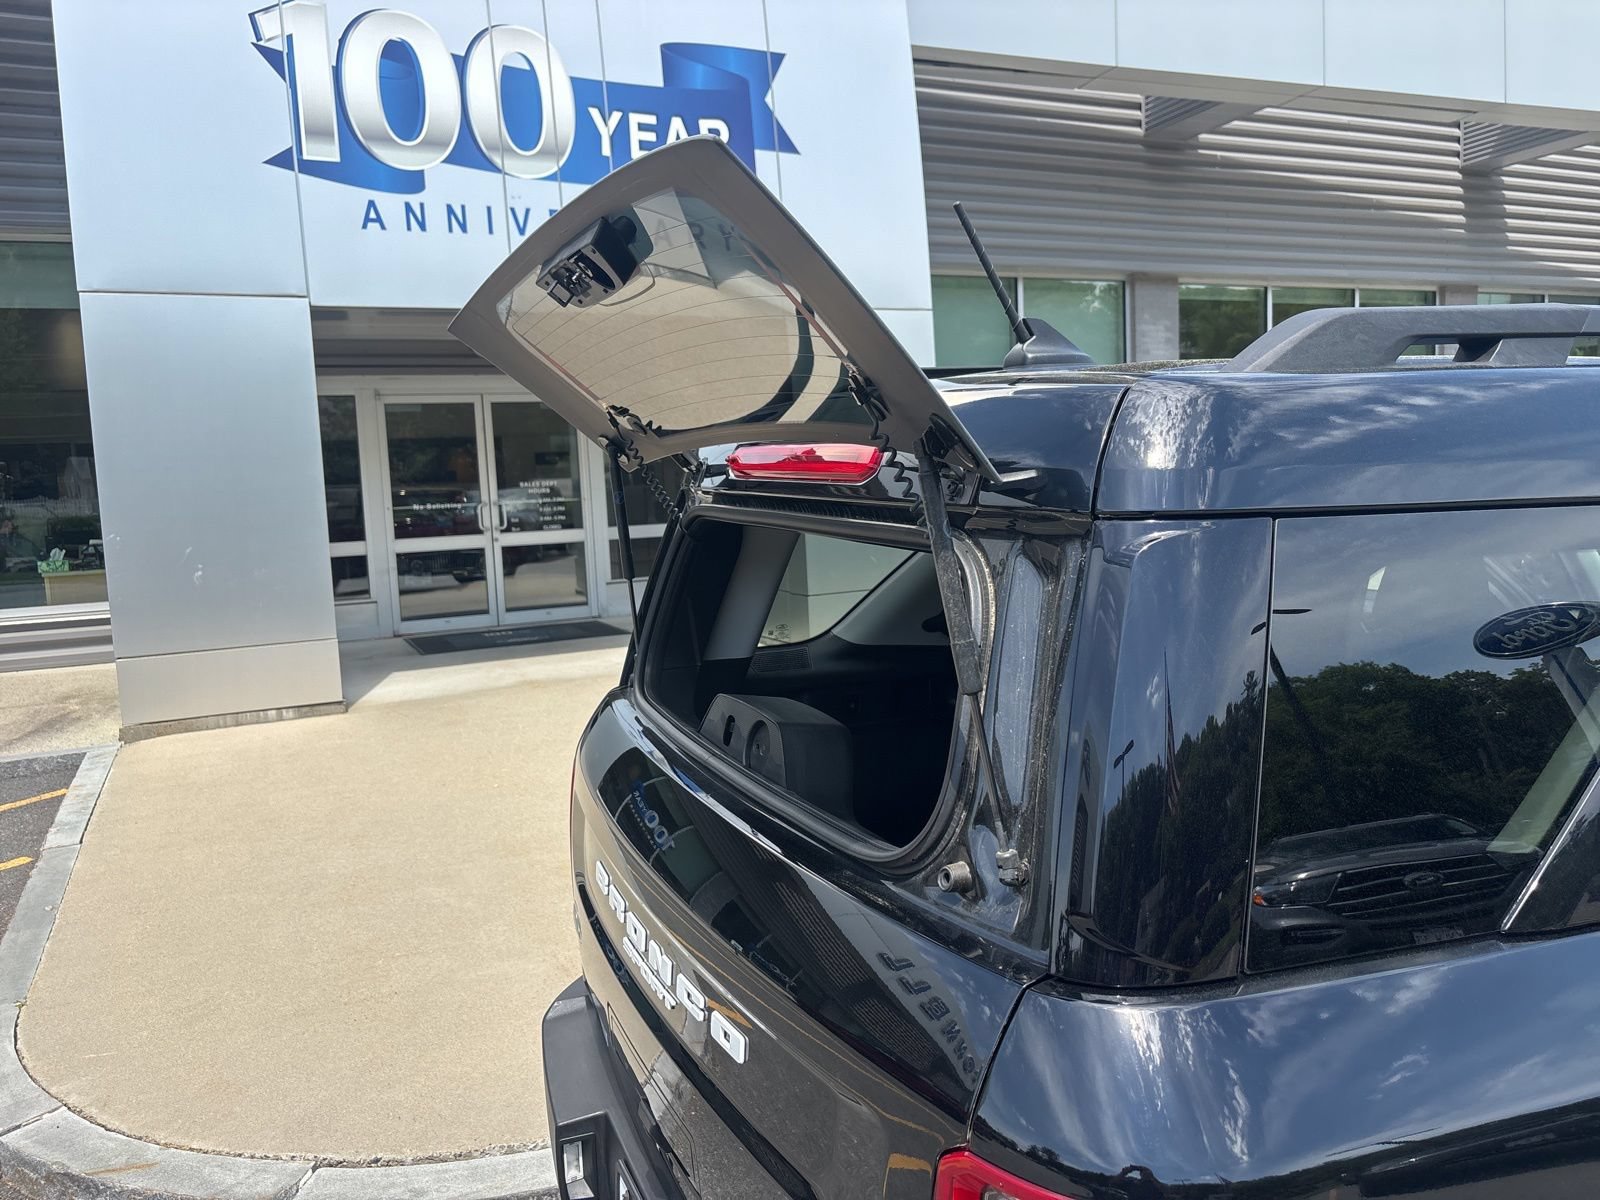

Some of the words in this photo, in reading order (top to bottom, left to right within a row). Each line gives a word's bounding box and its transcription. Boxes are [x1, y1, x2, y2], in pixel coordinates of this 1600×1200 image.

[249, 0, 576, 179] 100
[595, 860, 749, 1065] BRONCO
[622, 936, 680, 1010] SPORT
